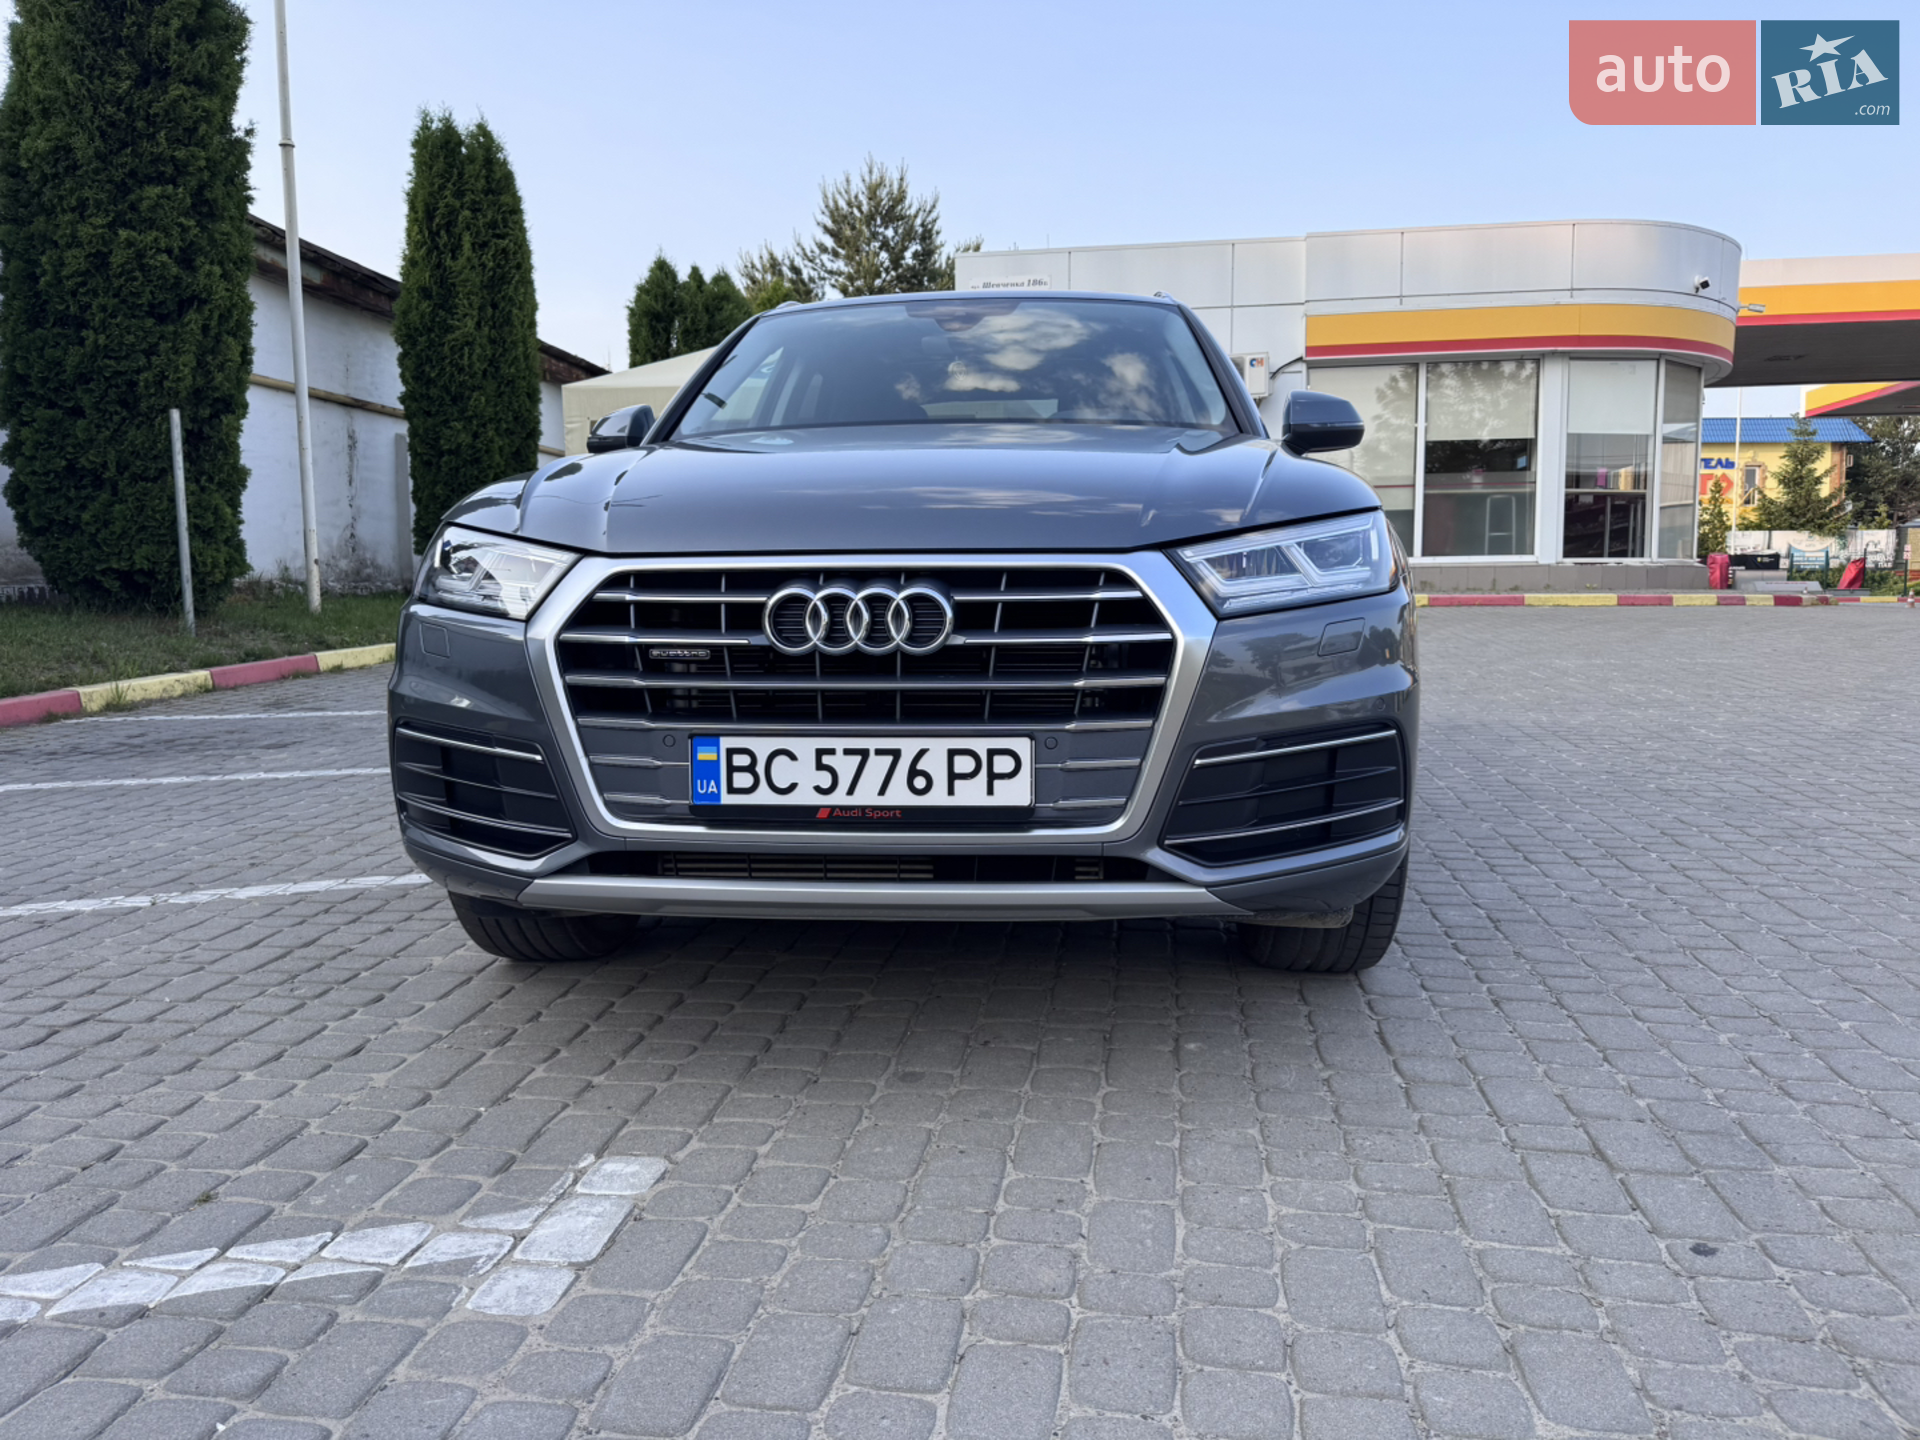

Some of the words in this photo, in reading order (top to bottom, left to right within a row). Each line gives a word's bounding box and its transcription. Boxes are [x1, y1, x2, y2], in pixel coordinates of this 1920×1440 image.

[725, 747, 799, 796] BC
[812, 747, 934, 797] 5776
[946, 747, 1023, 797] PP
[697, 779, 718, 794] UA
[832, 807, 862, 817] Audi
[864, 807, 902, 819] Sport
